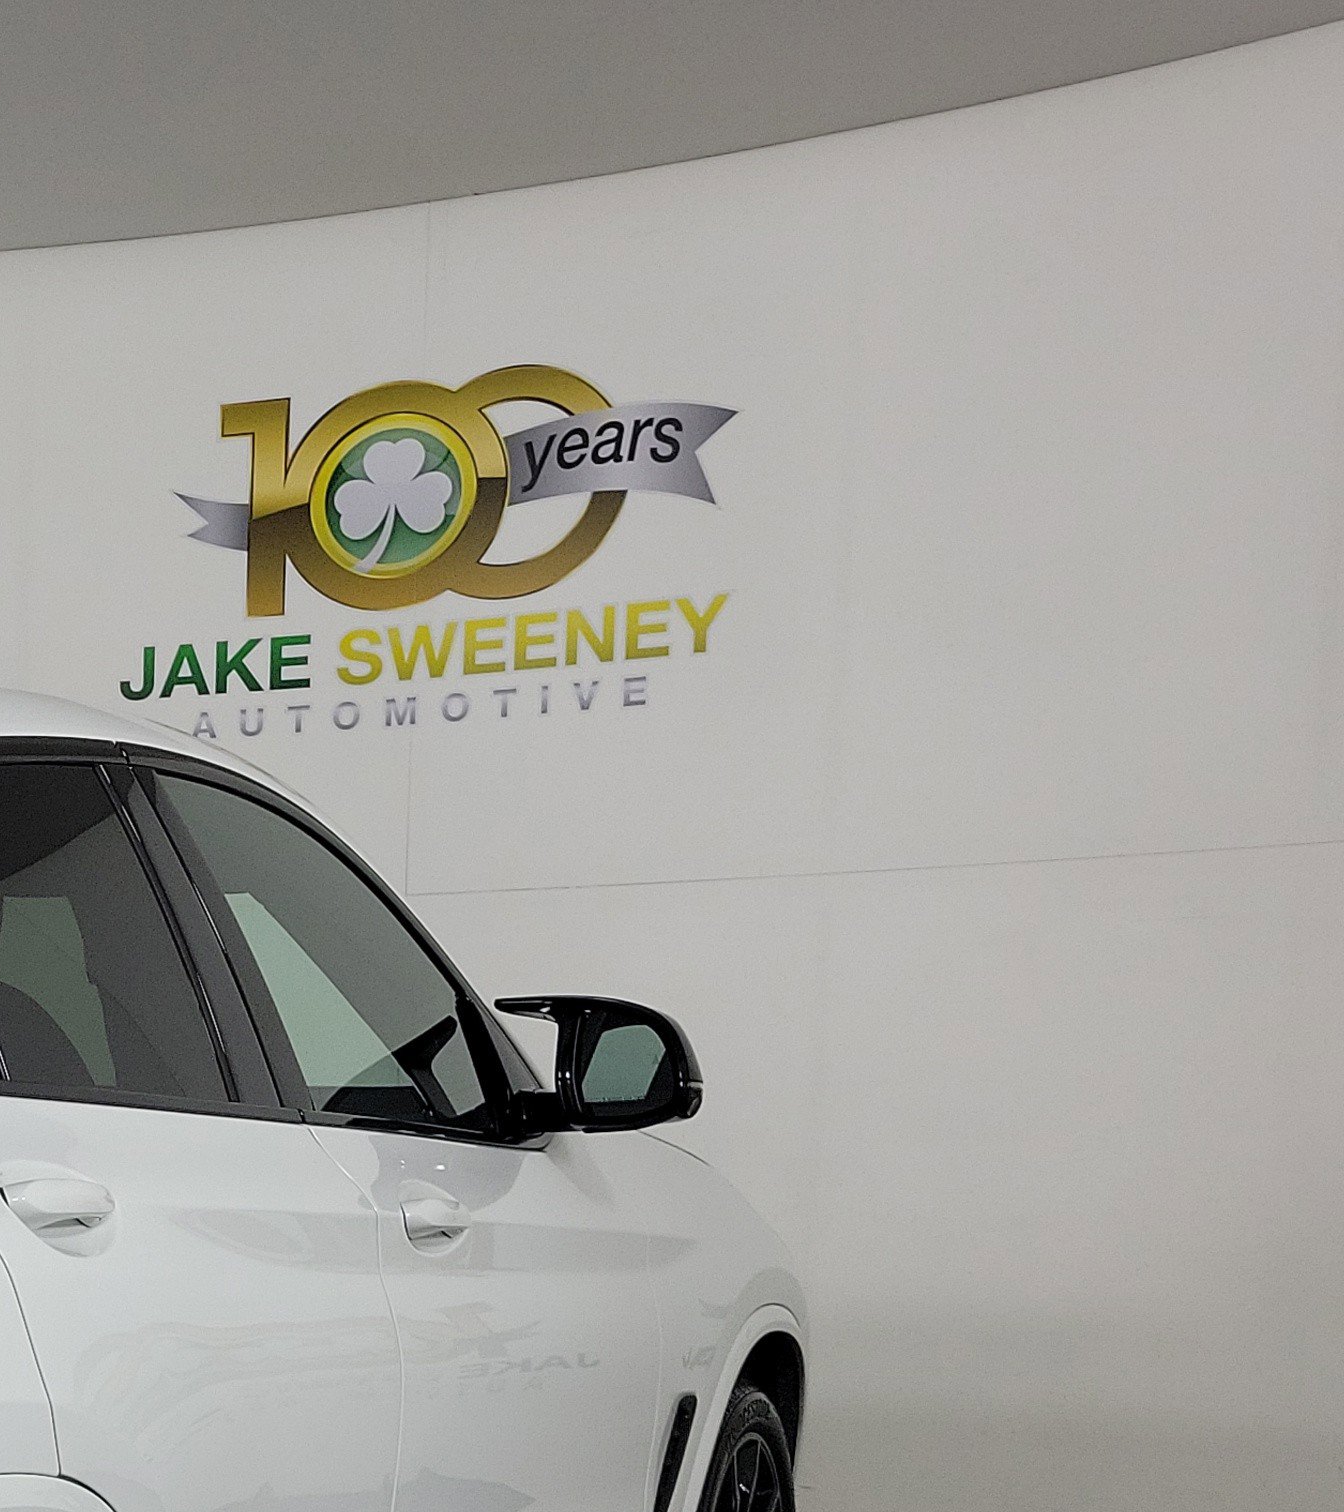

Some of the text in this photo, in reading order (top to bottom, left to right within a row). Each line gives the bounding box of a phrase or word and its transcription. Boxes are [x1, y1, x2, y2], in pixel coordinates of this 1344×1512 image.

[520, 415, 684, 493] years
[119, 593, 729, 701] JAKE SWEENEY
[192, 676, 648, 738] AUTOMOTIVE
